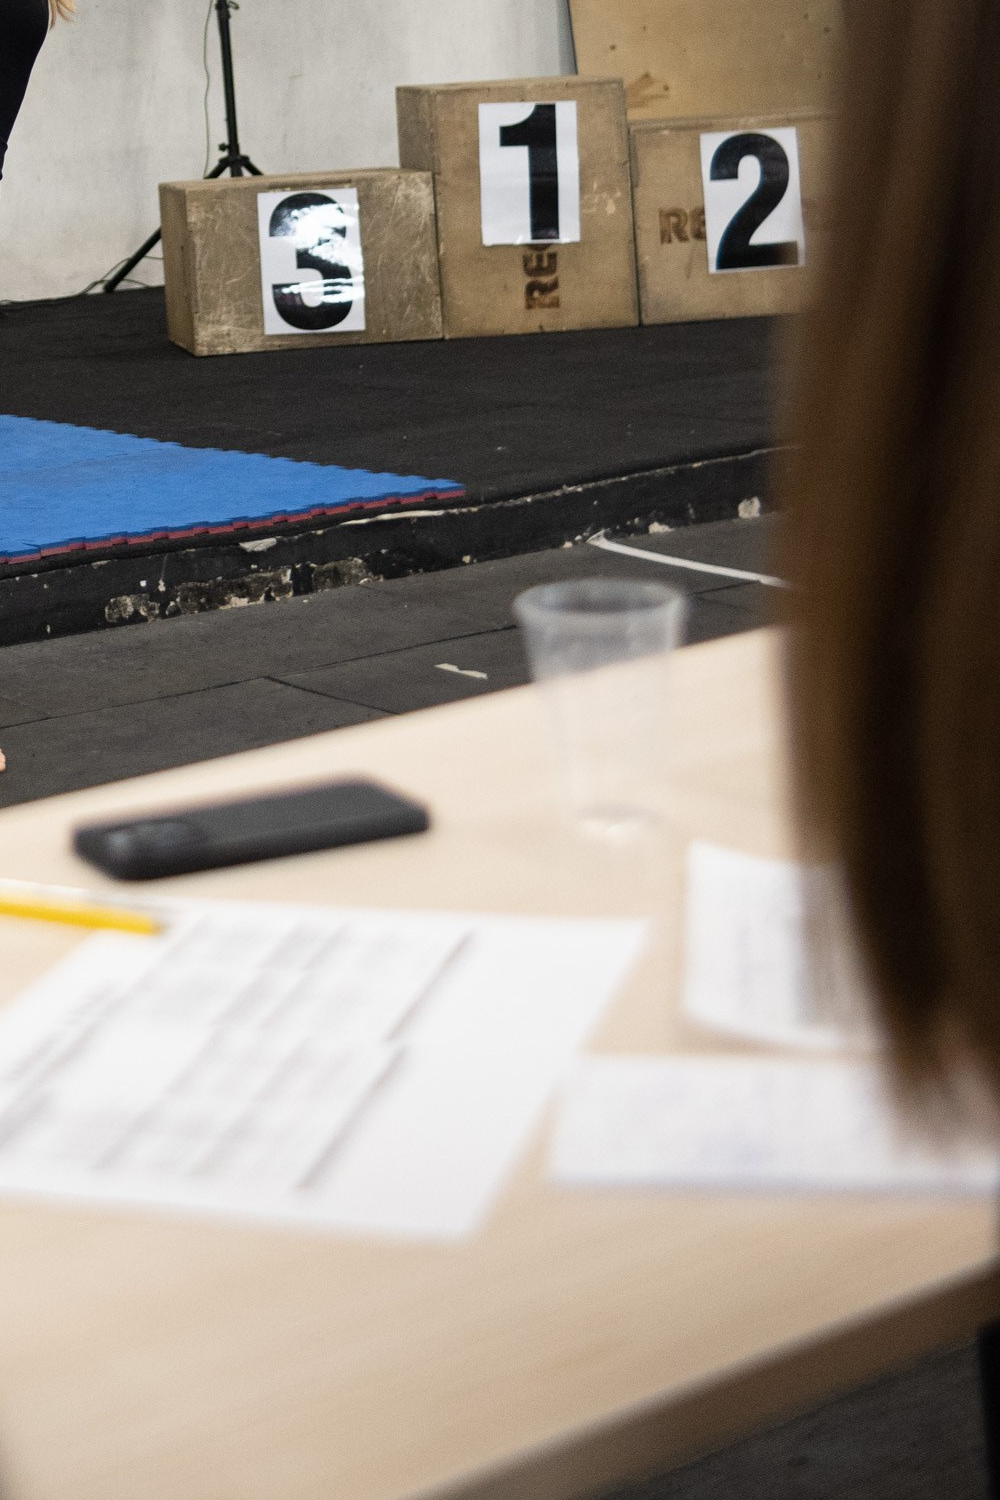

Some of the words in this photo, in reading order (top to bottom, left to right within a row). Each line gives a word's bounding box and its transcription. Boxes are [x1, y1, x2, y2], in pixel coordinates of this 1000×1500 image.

[499, 103, 560, 240] 1
[710, 132, 799, 270] 2
[269, 192, 353, 331] 3
[522, 242, 560, 310] RE
